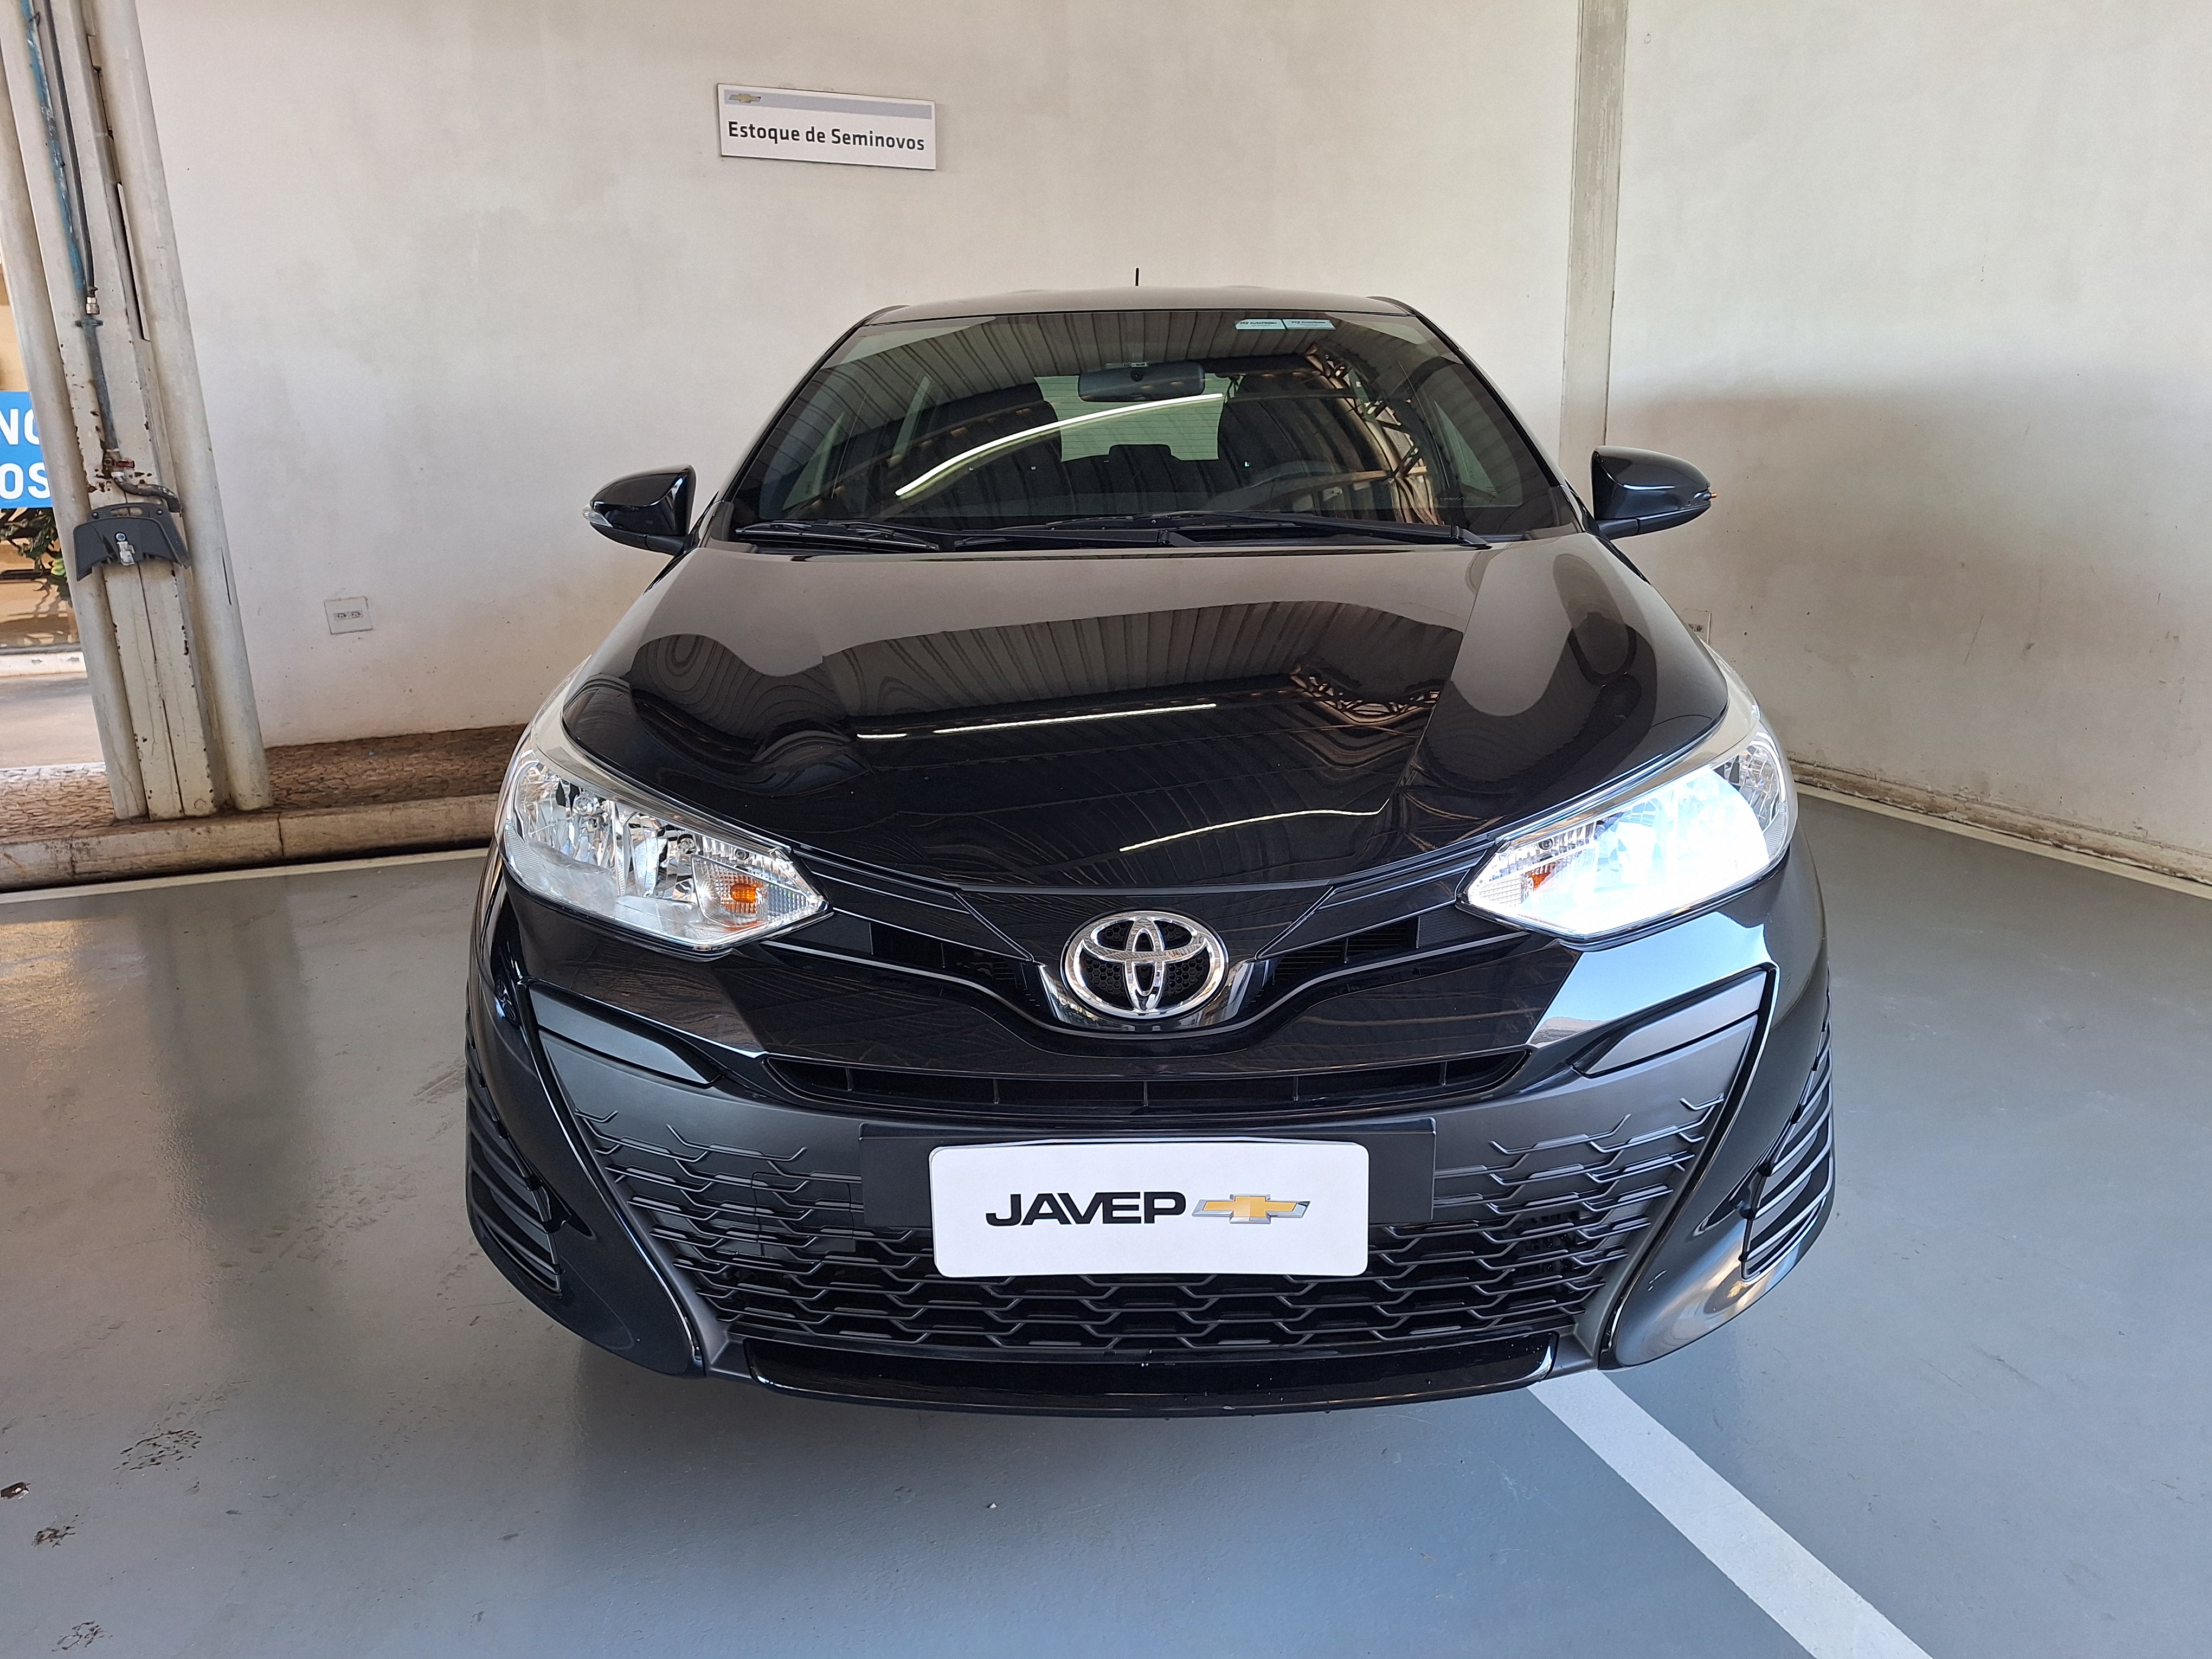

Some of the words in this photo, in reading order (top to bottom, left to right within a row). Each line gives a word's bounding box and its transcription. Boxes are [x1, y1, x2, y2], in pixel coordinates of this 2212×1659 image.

[728, 121, 800, 144] Estoque
[806, 126, 825, 143] de
[831, 128, 924, 151] Seminovos
[986, 1191, 1186, 1227] JAVEP
